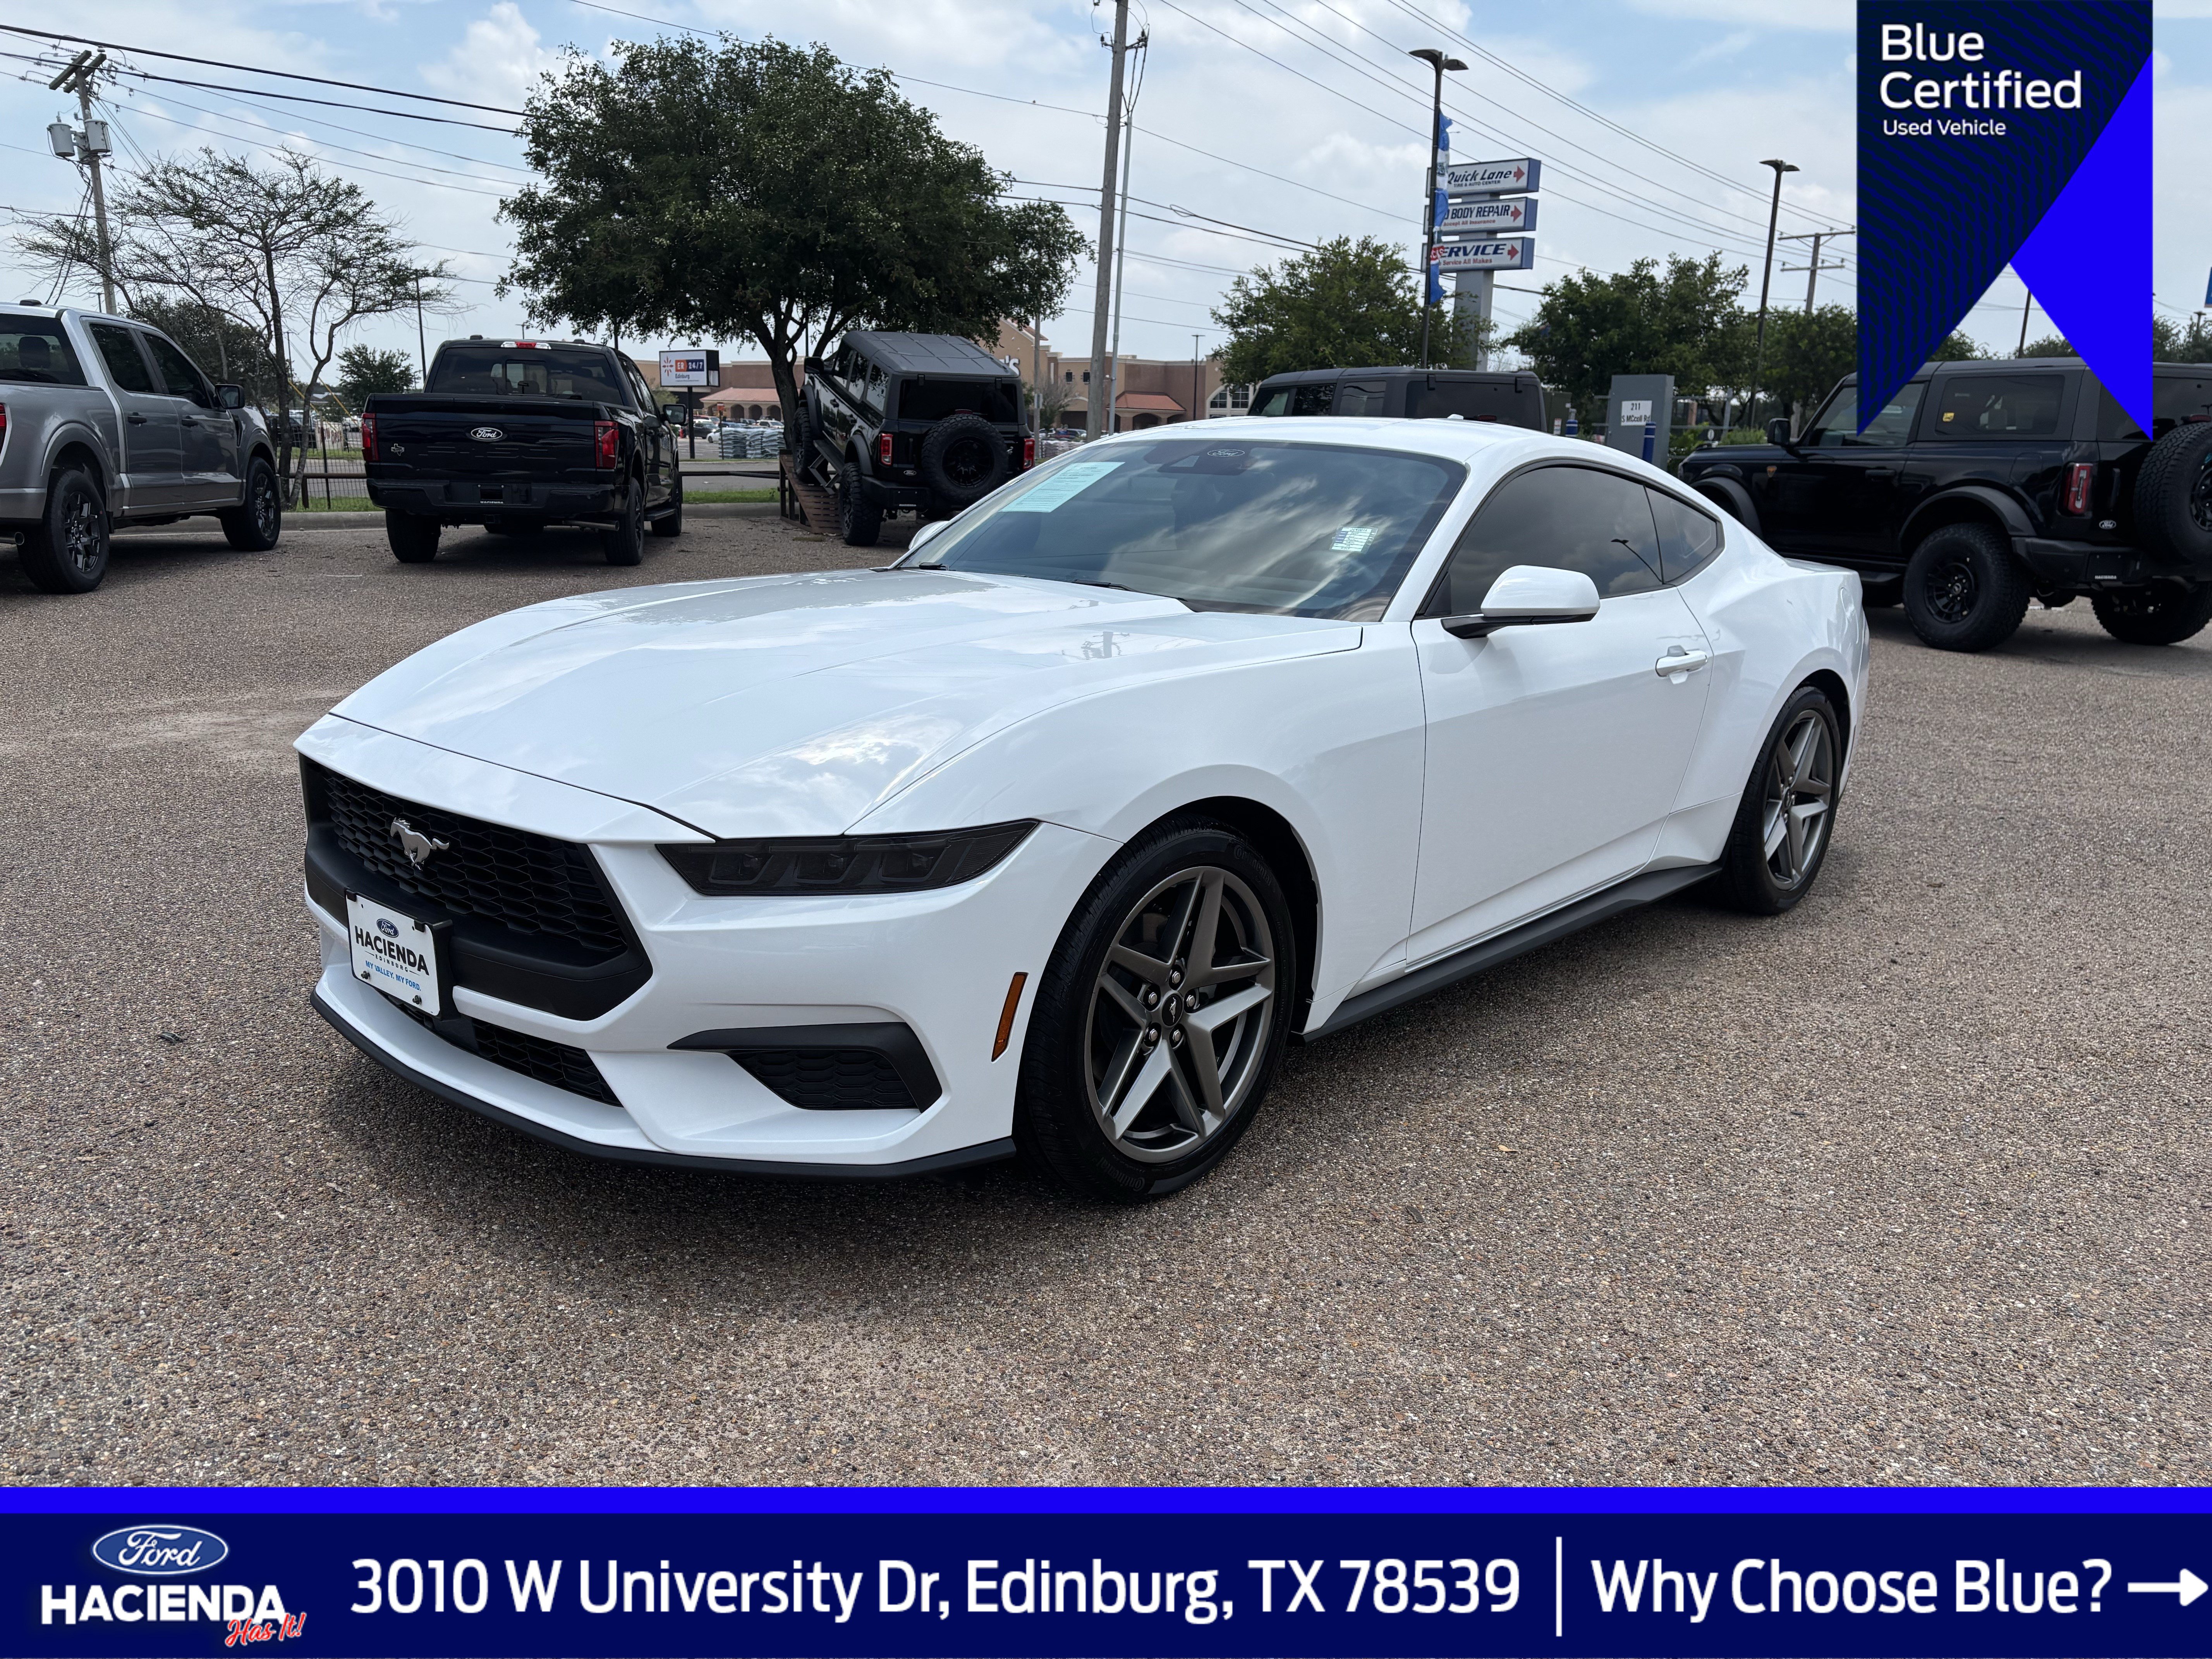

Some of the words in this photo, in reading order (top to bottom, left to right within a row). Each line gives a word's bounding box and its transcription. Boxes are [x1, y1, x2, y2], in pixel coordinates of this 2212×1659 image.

[1448, 170, 1479, 184] Quick
[1480, 169, 1512, 180] Lane
[1451, 207, 1475, 219] BODY
[1476, 205, 1510, 218] REPAIR
[1441, 244, 1506, 258] ERVICE
[476, 429, 497, 438] Ford
[381, 920, 395, 936] Ford
[354, 925, 429, 976] HACIENDA
[376, 954, 408, 972] EDINBURG
[366, 960, 373, 969] MY
[396, 974, 404, 983] MY
[405, 978, 421, 991] FORD.
